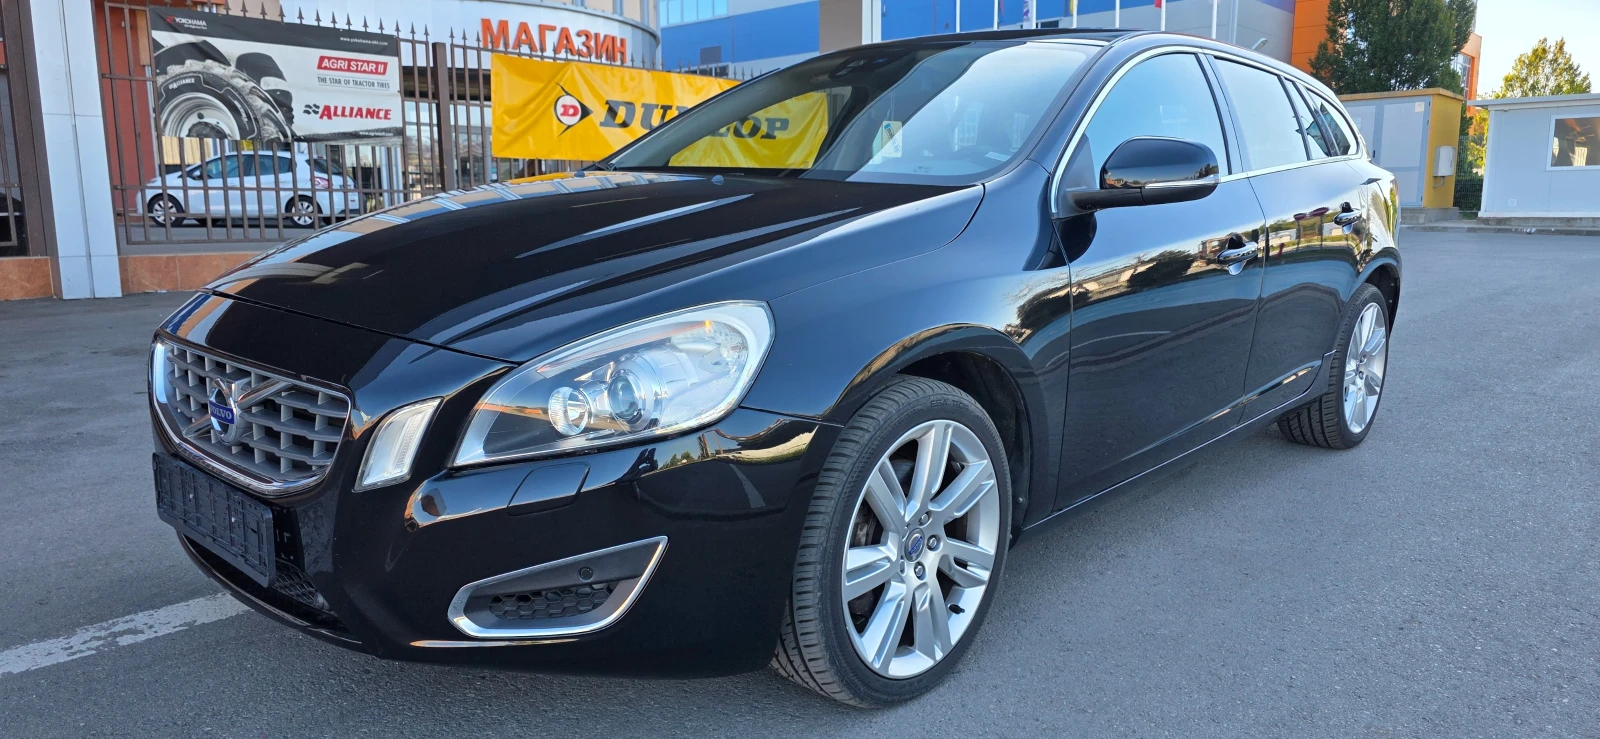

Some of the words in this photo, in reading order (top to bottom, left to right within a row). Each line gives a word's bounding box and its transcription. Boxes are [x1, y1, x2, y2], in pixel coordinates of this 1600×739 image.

[174, 16, 207, 26] YOKOHAMA
[481, 18, 627, 64] МАГАЗИН
[321, 58, 348, 70] AGRI
[349, 61, 376, 73] STAR
[377, 64, 385, 74] II
[317, 76, 328, 84] THE
[328, 77, 342, 86] STAR
[343, 78, 351, 86] OF
[352, 79, 376, 88] TRACTOR
[376, 81, 390, 89] TIRES
[319, 104, 392, 120] ALLIANCE
[599, 99, 789, 140] DULOP
[210, 405, 232, 420] VOLVO
